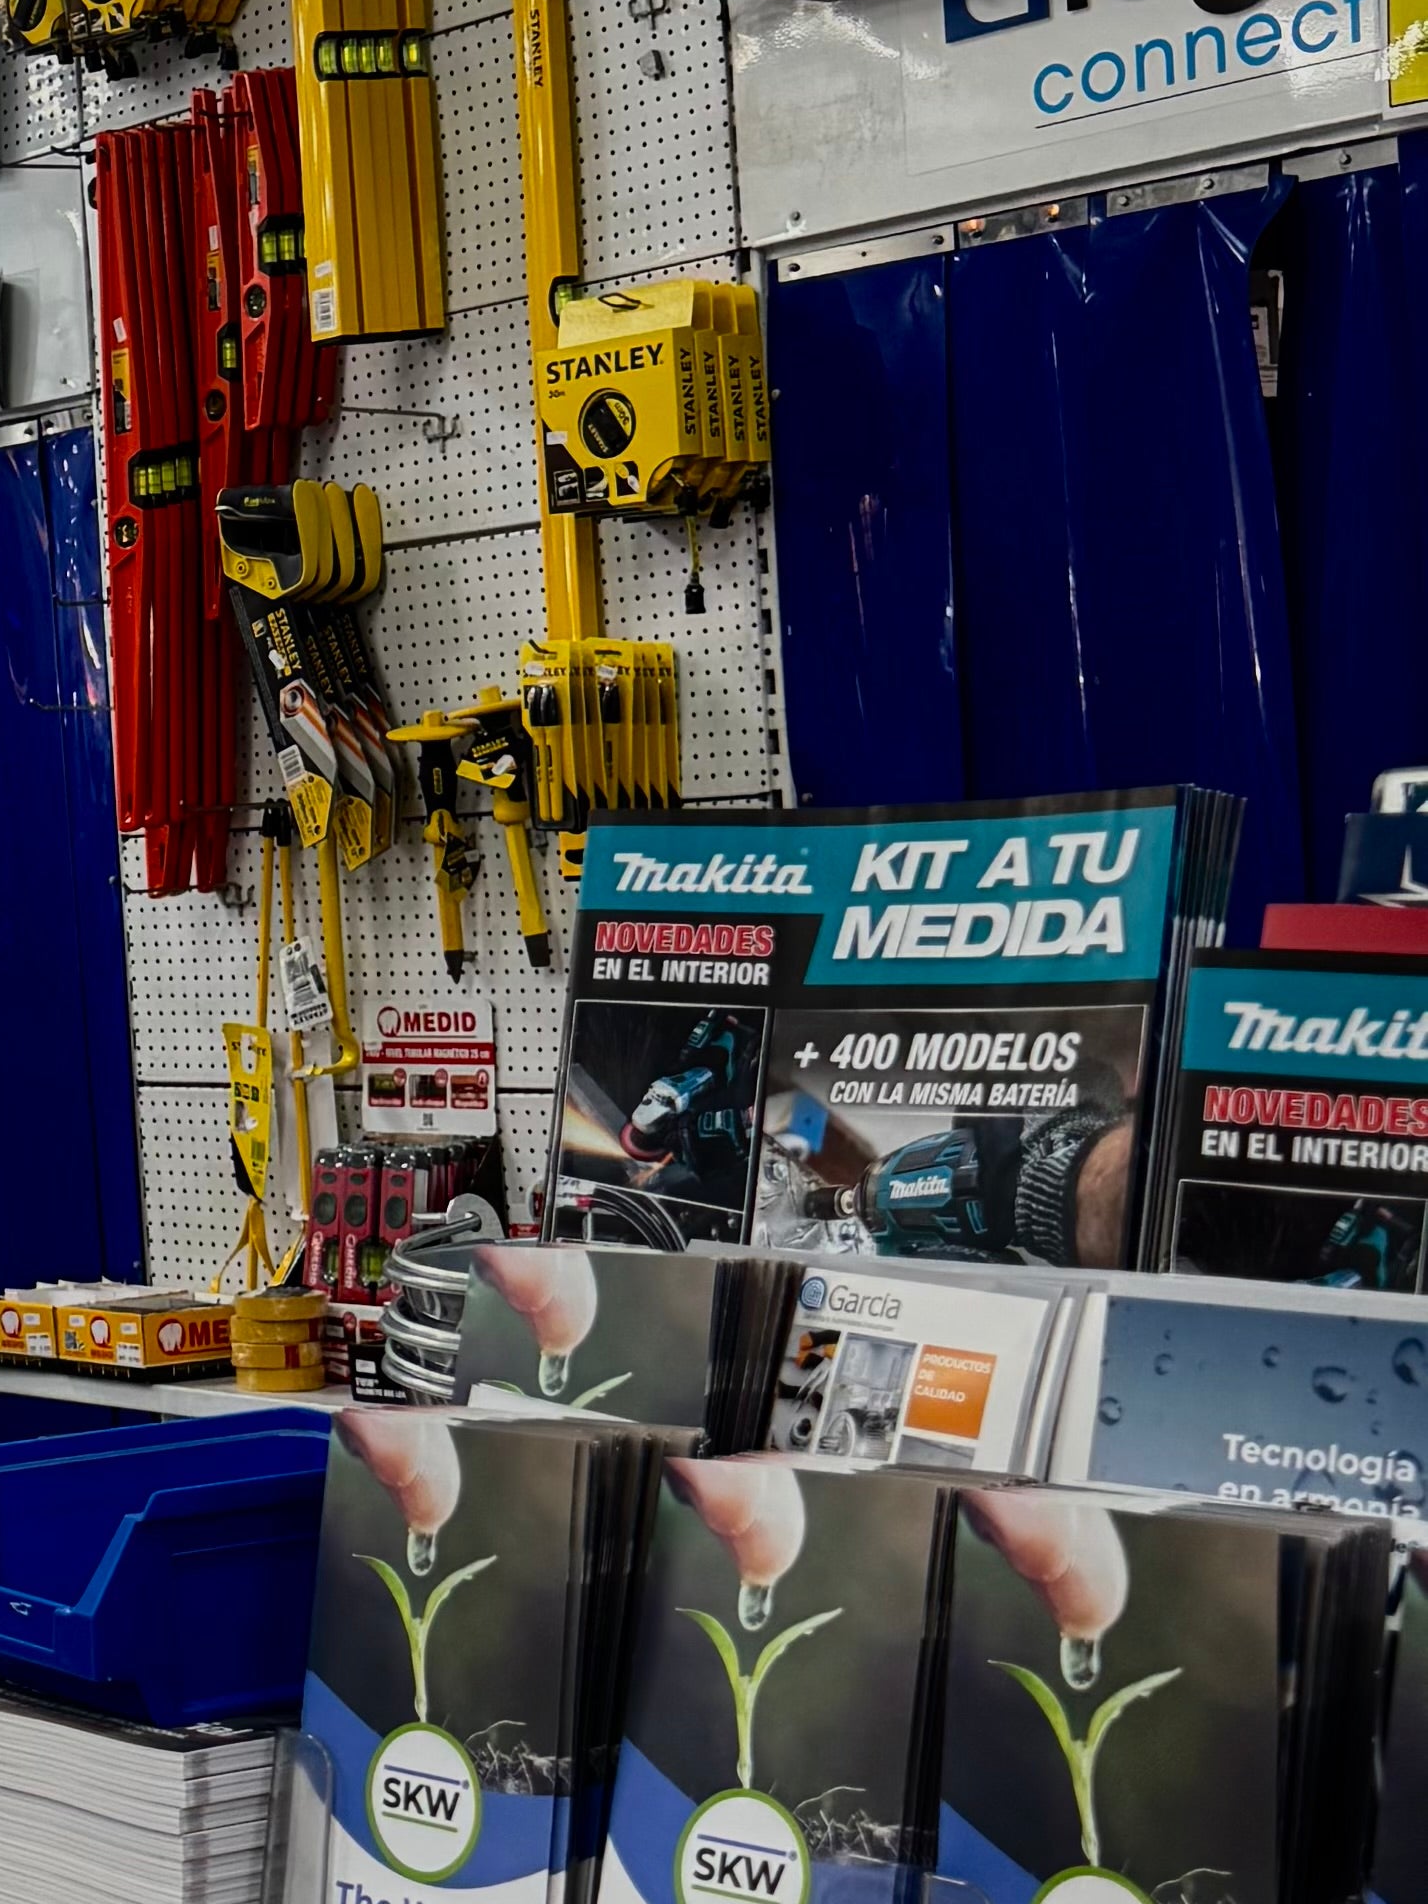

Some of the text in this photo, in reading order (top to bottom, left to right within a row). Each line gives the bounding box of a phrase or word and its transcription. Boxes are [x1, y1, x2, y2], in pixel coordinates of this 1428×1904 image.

[527, 7, 547, 89] STANLEY
[546, 342, 663, 384] STANLEY
[680, 347, 698, 436] STANLEY
[703, 351, 721, 438] STANLEY
[728, 354, 745, 441] STANLEY
[749, 356, 767, 442] STANLEY
[275, 607, 302, 671] STANLEY
[307, 635, 334, 695] STANLEY
[326, 625, 352, 684] STANLEY
[850, 827, 1140, 893] KIT A TU
[593, 920, 776, 958] NOVEDADES
[830, 897, 1127, 962] MEDIDA
[593, 957, 771, 986] EN EL INTERIOR
[403, 1011, 476, 1033] MEDID
[828, 1032, 901, 1071] 400
[908, 1031, 1082, 1074] MODELOS
[828, 1075, 1080, 1108] CON LA MISMA BATERÍA
[1203, 1086, 1428, 1137] NOVEDADES
[1202, 1131, 1240, 1158] EN
[1249, 1134, 1284, 1162] EL
[917, 1369, 934, 1383] DE
[923, 1352, 993, 1375] PRODUCTOS
[914, 1383, 966, 1404] CALIDAD
[1222, 1433, 1418, 1486] Tecnología
[381, 1771, 462, 1821] SKW
[692, 1845, 786, 1899] SKW
